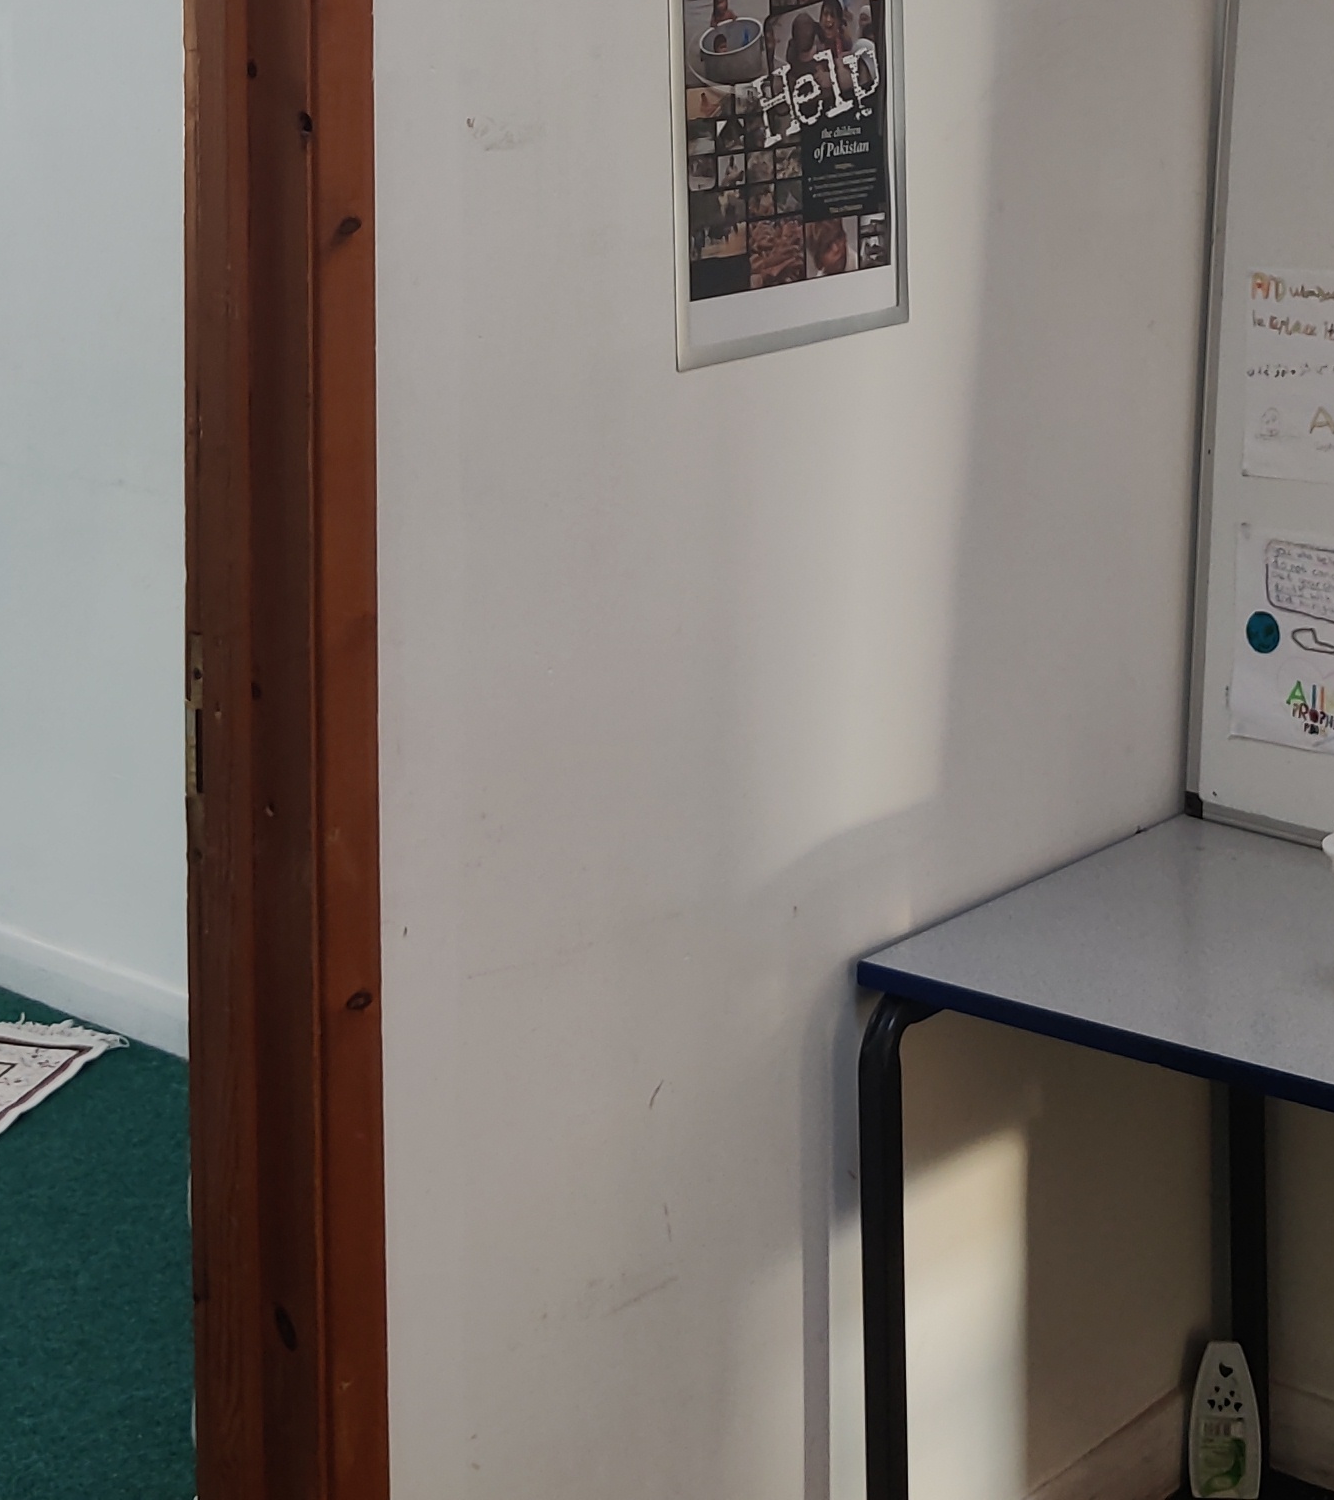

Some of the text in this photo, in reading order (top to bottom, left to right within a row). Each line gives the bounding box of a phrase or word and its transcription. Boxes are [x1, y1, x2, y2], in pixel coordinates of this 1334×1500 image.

[752, 48, 880, 148] Help
[813, 140, 870, 163] of Pakistan
